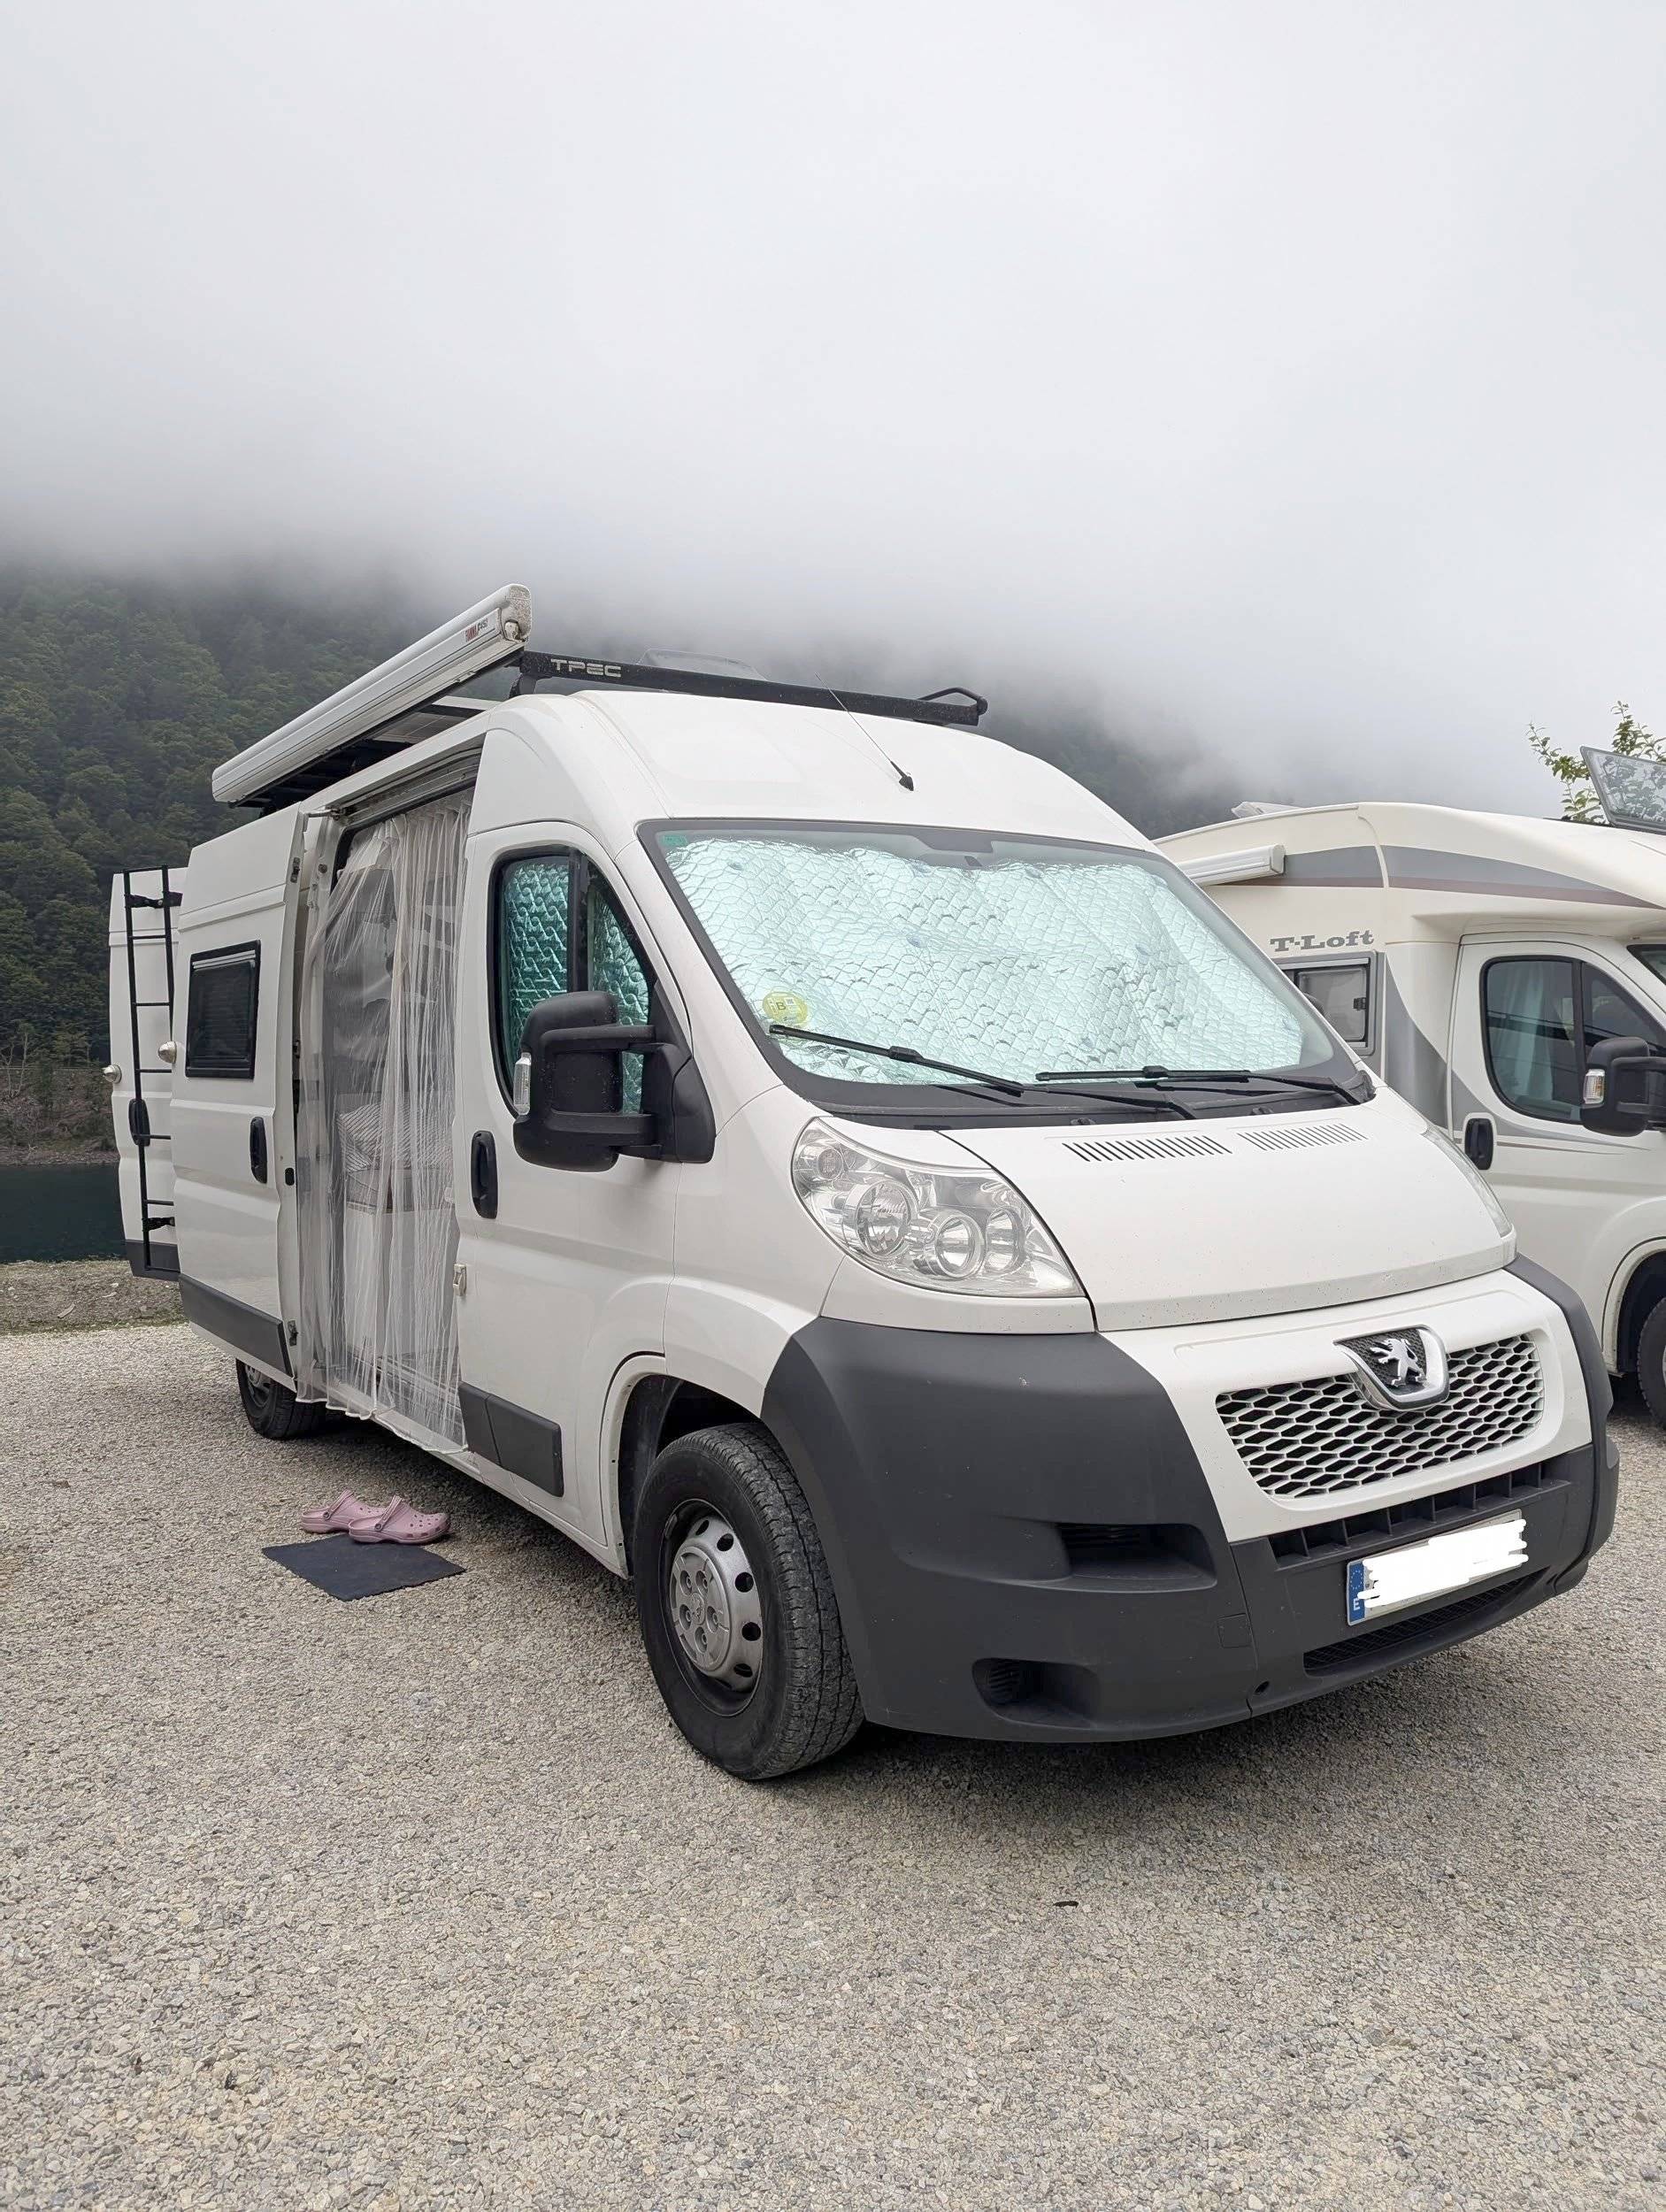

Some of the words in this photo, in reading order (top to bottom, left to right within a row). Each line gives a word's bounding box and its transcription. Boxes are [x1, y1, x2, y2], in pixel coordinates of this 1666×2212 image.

[550, 658, 621, 678] TPEC
[1270, 930, 1374, 952] T-Loft
[1353, 1598, 1360, 1610] E
